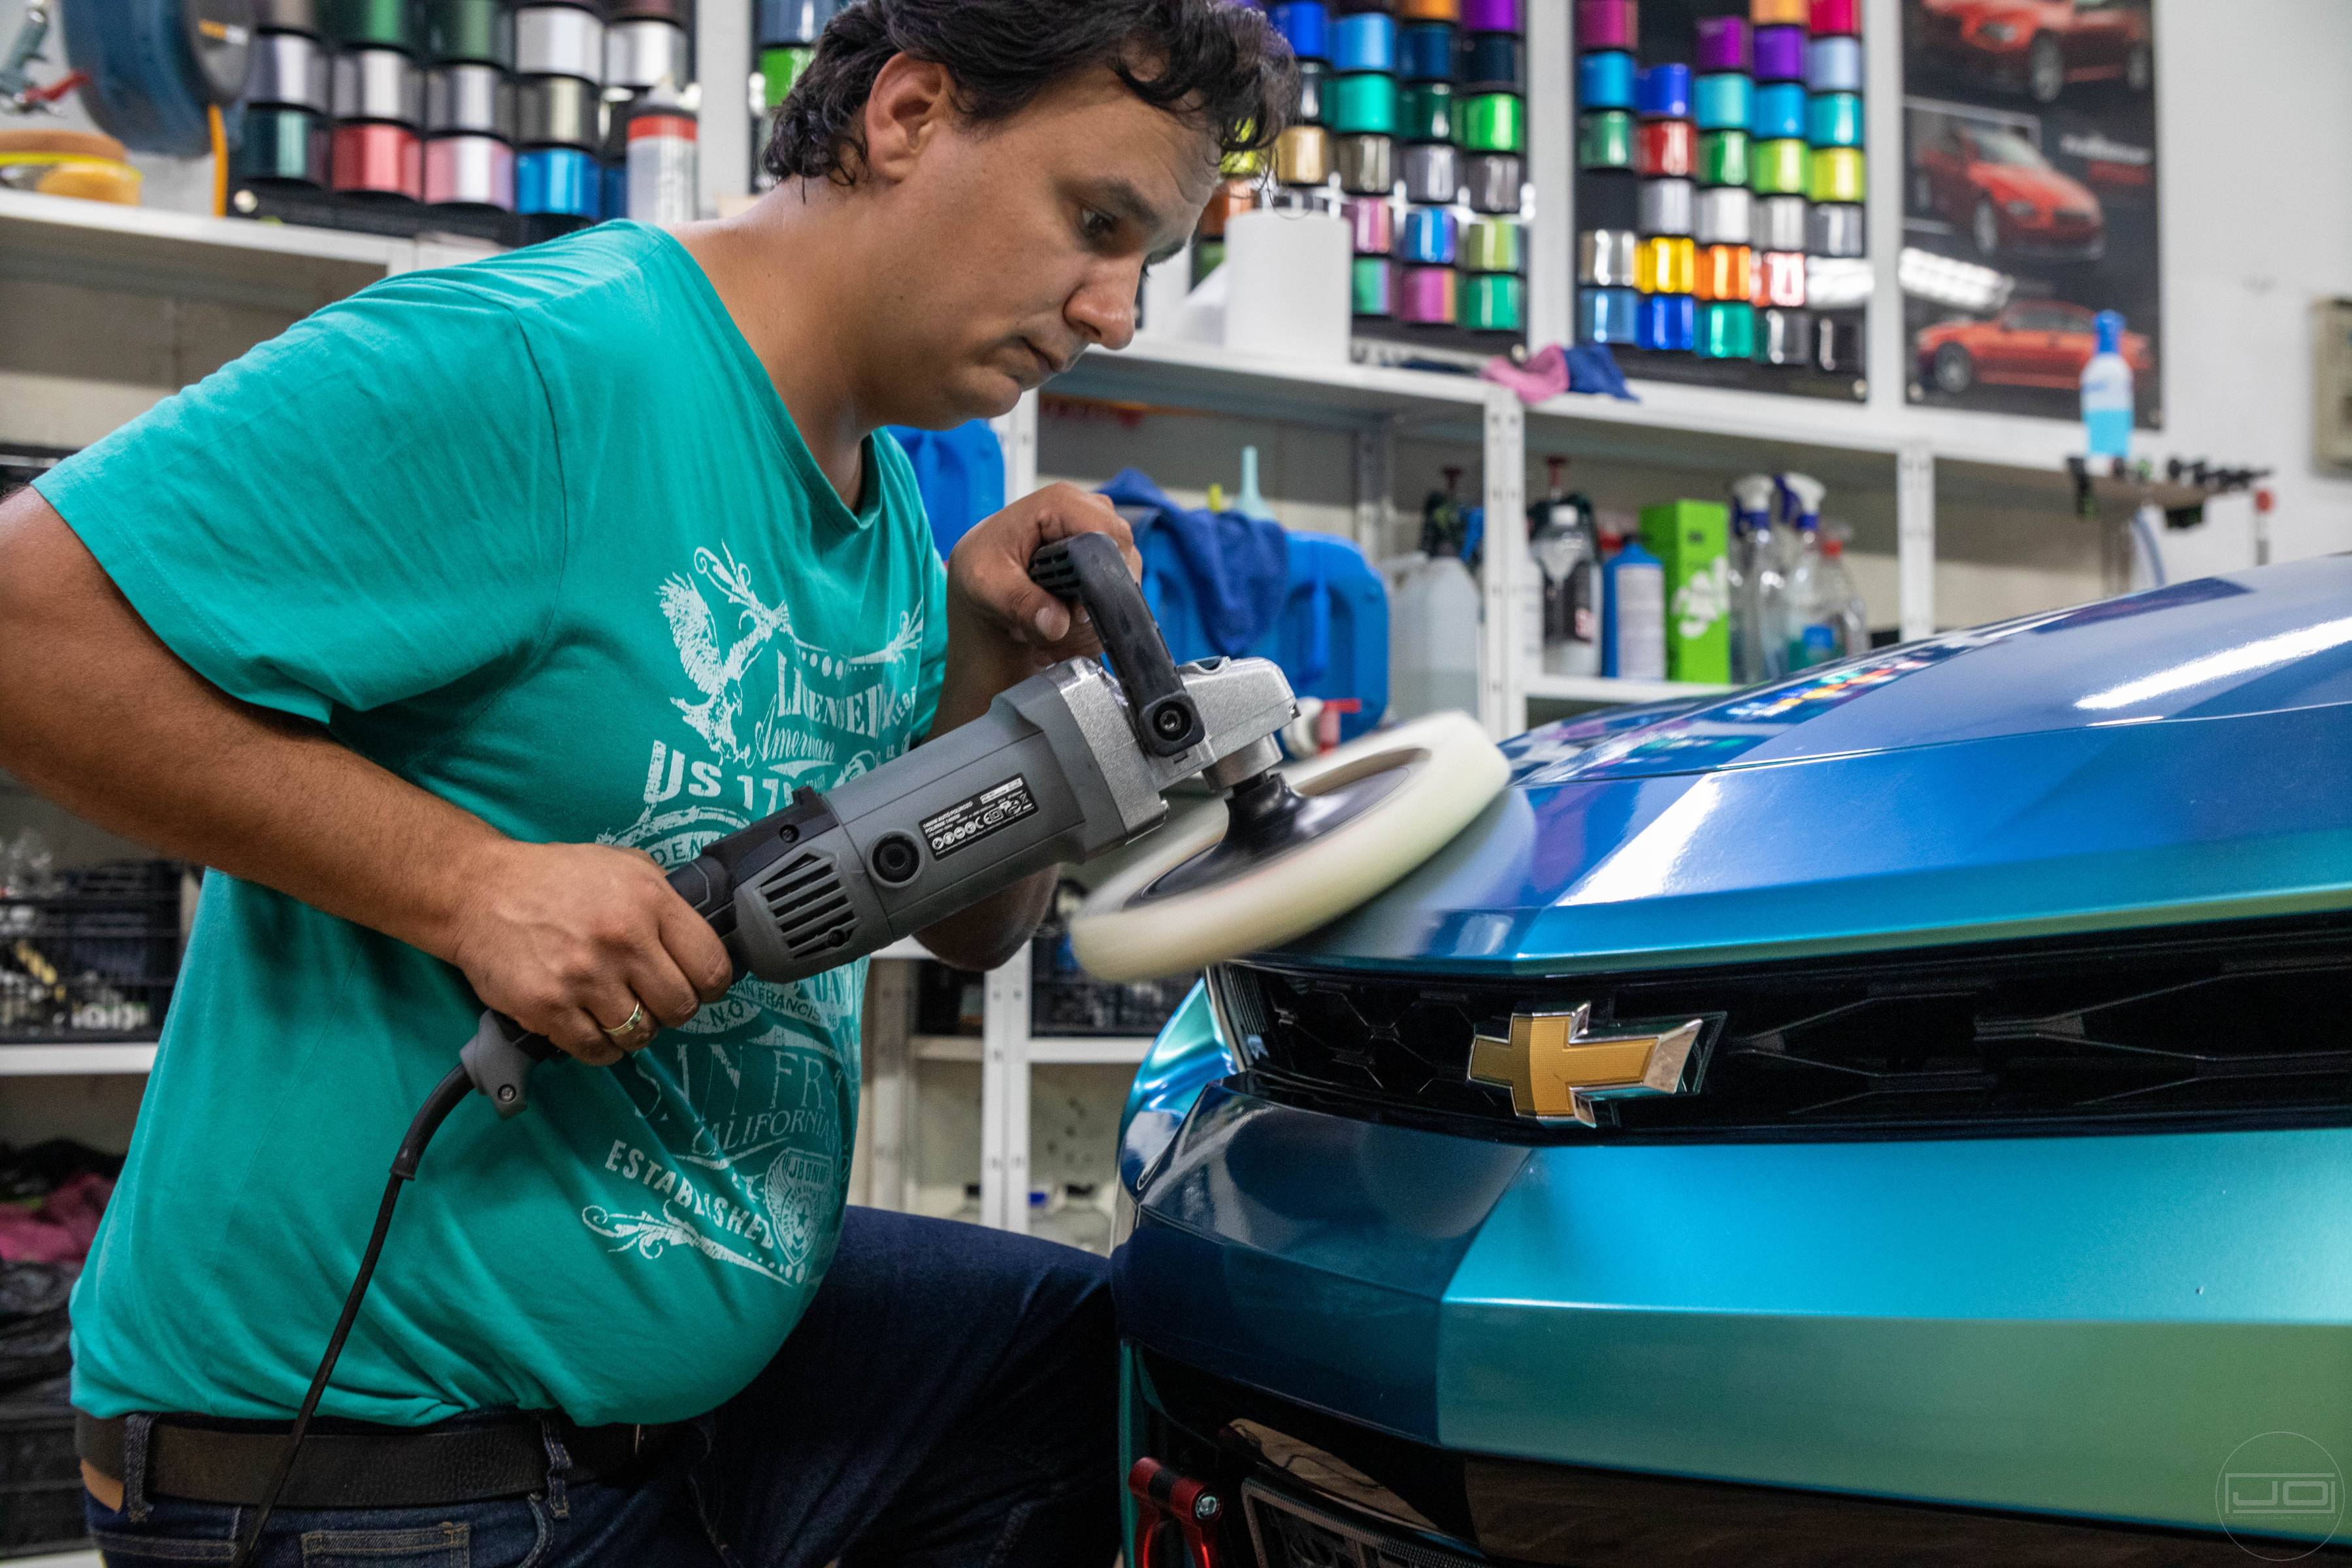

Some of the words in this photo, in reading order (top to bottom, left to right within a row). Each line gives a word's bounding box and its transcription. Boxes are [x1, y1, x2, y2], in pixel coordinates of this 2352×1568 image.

[644, 740, 722, 804] US
[769, 1050, 827, 1113] FR
[605, 1139, 774, 1249] ESTABLISHED
